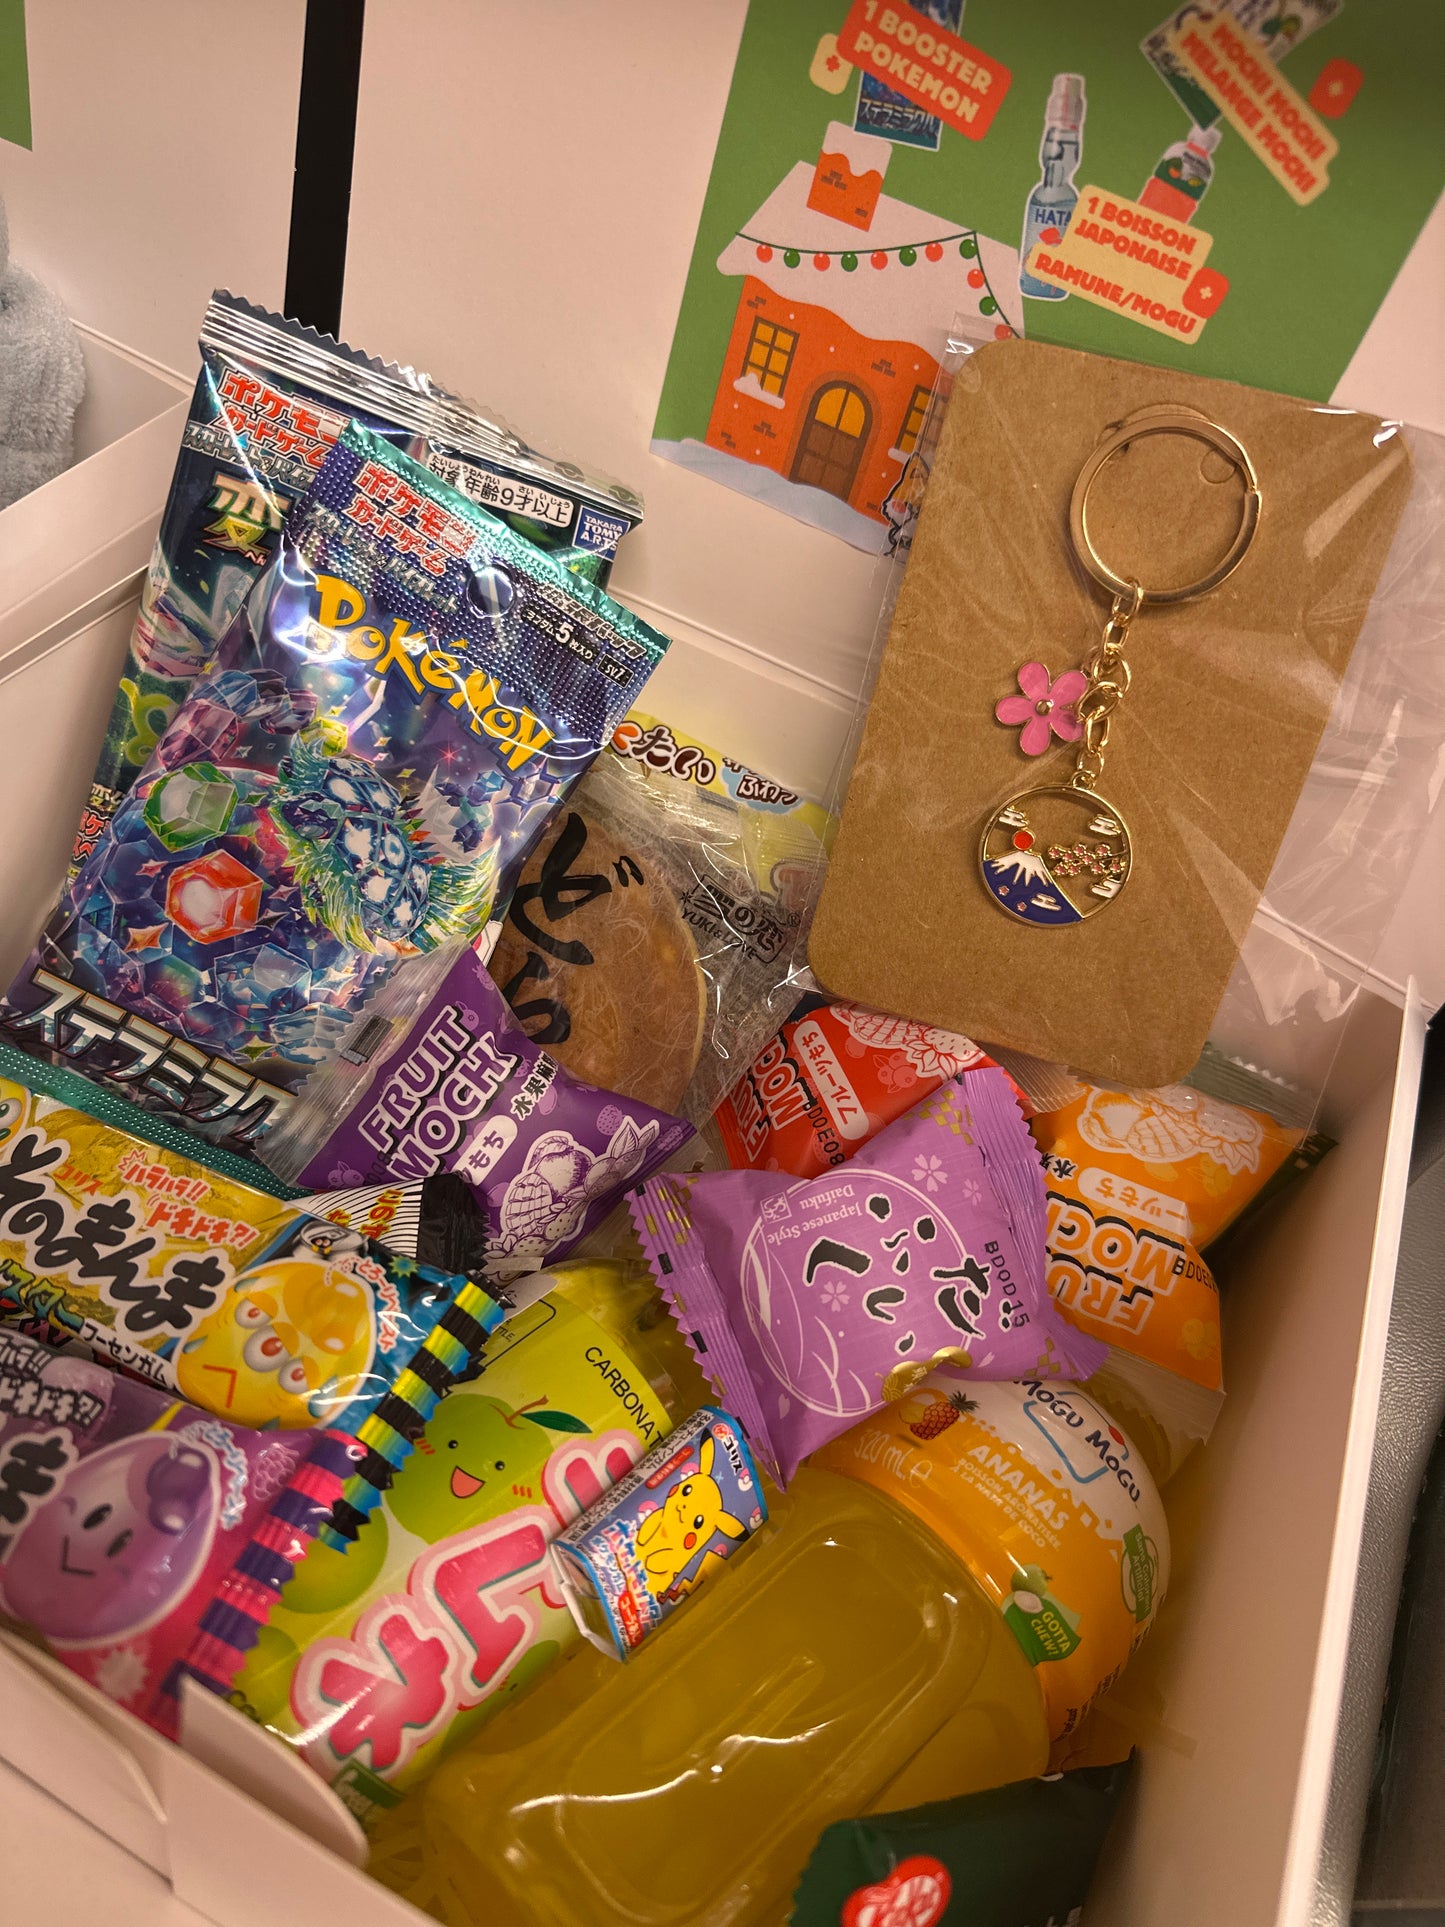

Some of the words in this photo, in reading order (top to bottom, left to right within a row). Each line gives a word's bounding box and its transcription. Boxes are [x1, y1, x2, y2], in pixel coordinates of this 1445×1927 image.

[854, 31, 980, 123] POKEMON
[865, 0, 878, 21] 1
[878, 9, 993, 95] BOOSTER
[1266, 89, 1327, 161] MOCHI
[1256, 124, 1317, 194] MOCHI
[1074, 219, 1192, 281] JAPONAISE
[1088, 196, 1099, 214] 1
[1100, 201, 1197, 255] BOISSON
[1035, 253, 1197, 335] RAMUNE/MOGU
[345, 492, 449, 577] カードゲーム
[583, 524, 622, 540] TOMY
[584, 514, 624, 532] TAKARA
[358, 1004, 472, 1152] FRUIT
[802, 1030, 858, 1128] フルーツもち
[53, 1164, 104, 1198] コリス
[799, 1184, 856, 1211] Daifuku
[766, 1223, 802, 1246] Style
[801, 1202, 863, 1232] Japanese
[584, 1345, 666, 1449] CARBONAT
[720, 1436, 743, 1475] コリス
[957, 1457, 1003, 1495] BOISSON
[968, 1444, 1070, 1530] ANANAS
[1030, 1617, 1060, 1658] CHEW!
[1041, 1609, 1072, 1655] GOTTA
